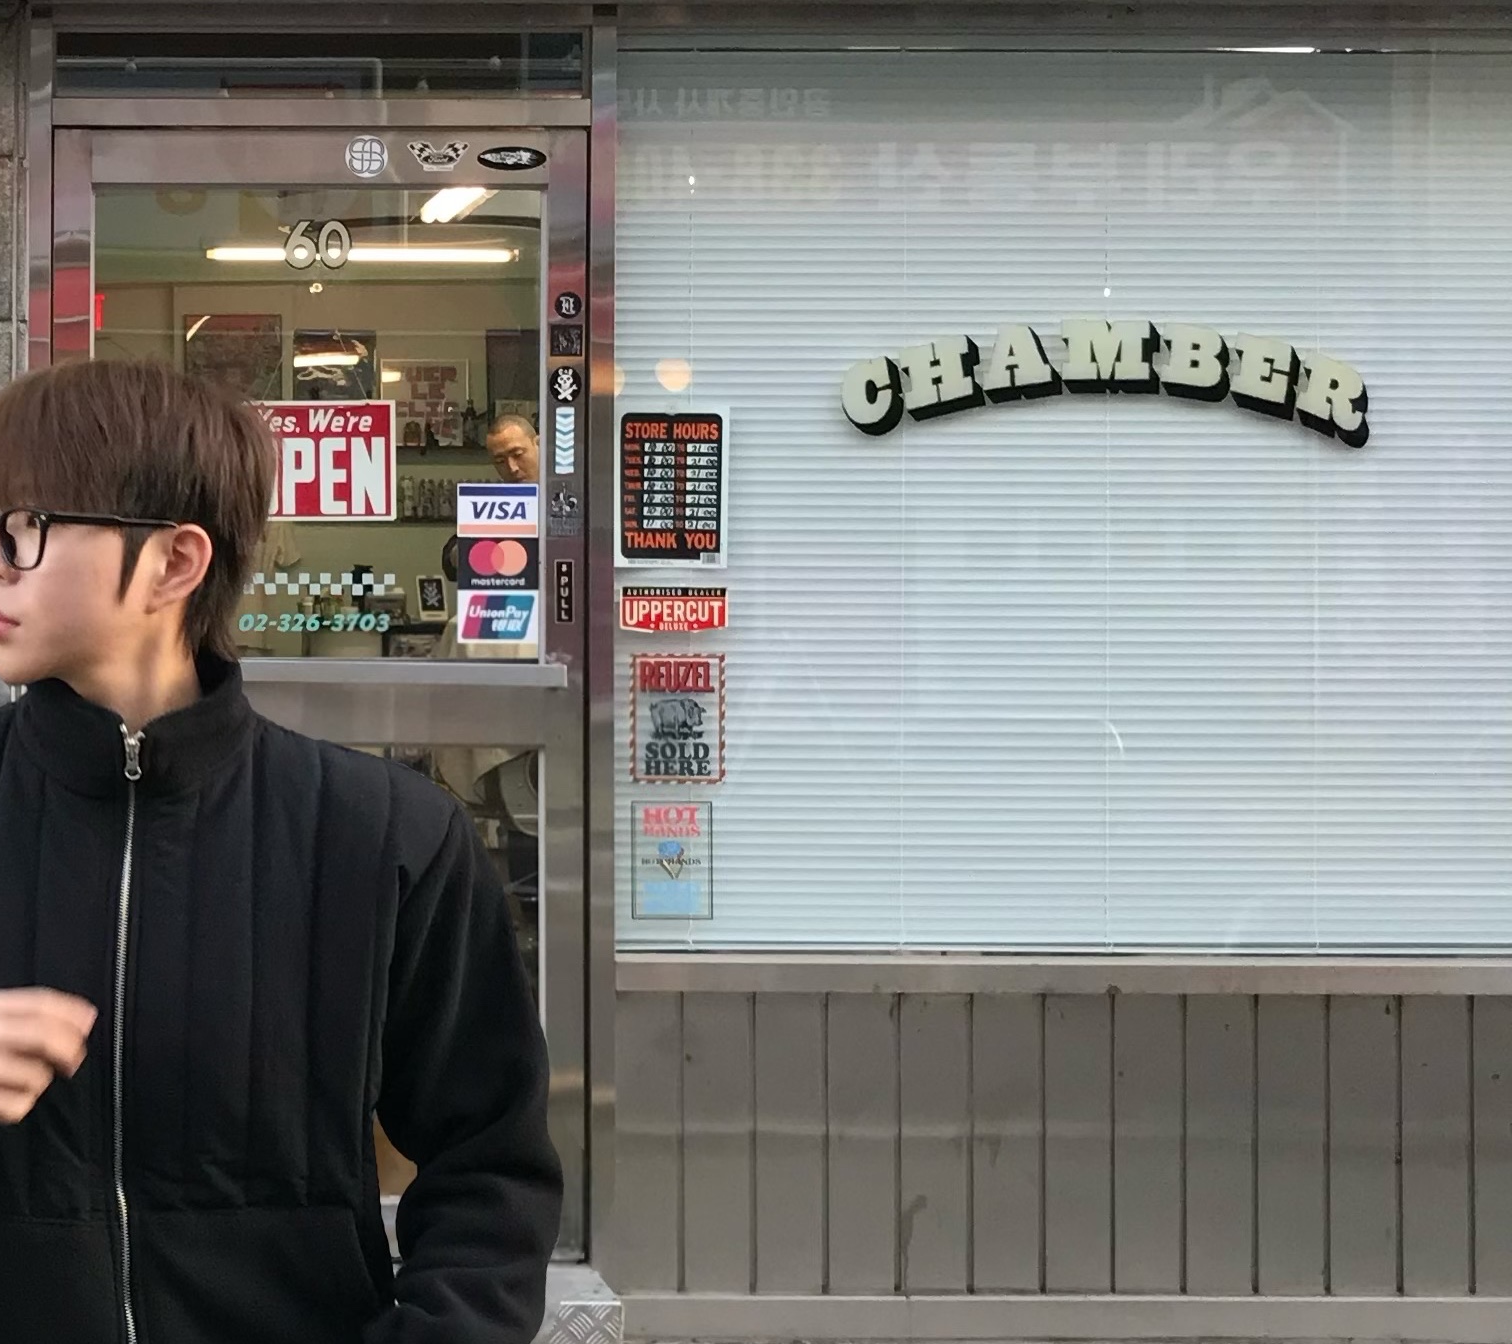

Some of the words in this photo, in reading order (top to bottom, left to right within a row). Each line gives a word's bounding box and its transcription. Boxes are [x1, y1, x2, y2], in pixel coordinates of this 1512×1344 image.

[284, 218, 353, 271] 60
[841, 318, 1370, 449] CHAMBER
[309, 408, 373, 433] We're
[624, 422, 668, 439] STORE
[673, 422, 719, 440] HOURS
[268, 436, 386, 516] PEN
[471, 501, 527, 520] VISA
[624, 531, 677, 549] THANK
[684, 532, 717, 550] YOU
[471, 577, 526, 586] mastercard
[559, 575, 569, 620] PULL
[626, 588, 682, 596] AUTHORISED
[469, 605, 530, 619] UnionPay
[624, 600, 723, 626] UPPERCUT
[238, 613, 391, 633] 02-326-3703
[658, 622, 689, 631] DELUXE
[639, 660, 715, 693] REUZEL
[644, 741, 710, 760] SOLD
[644, 759, 712, 776] HERE
[643, 805, 700, 825] HOT
